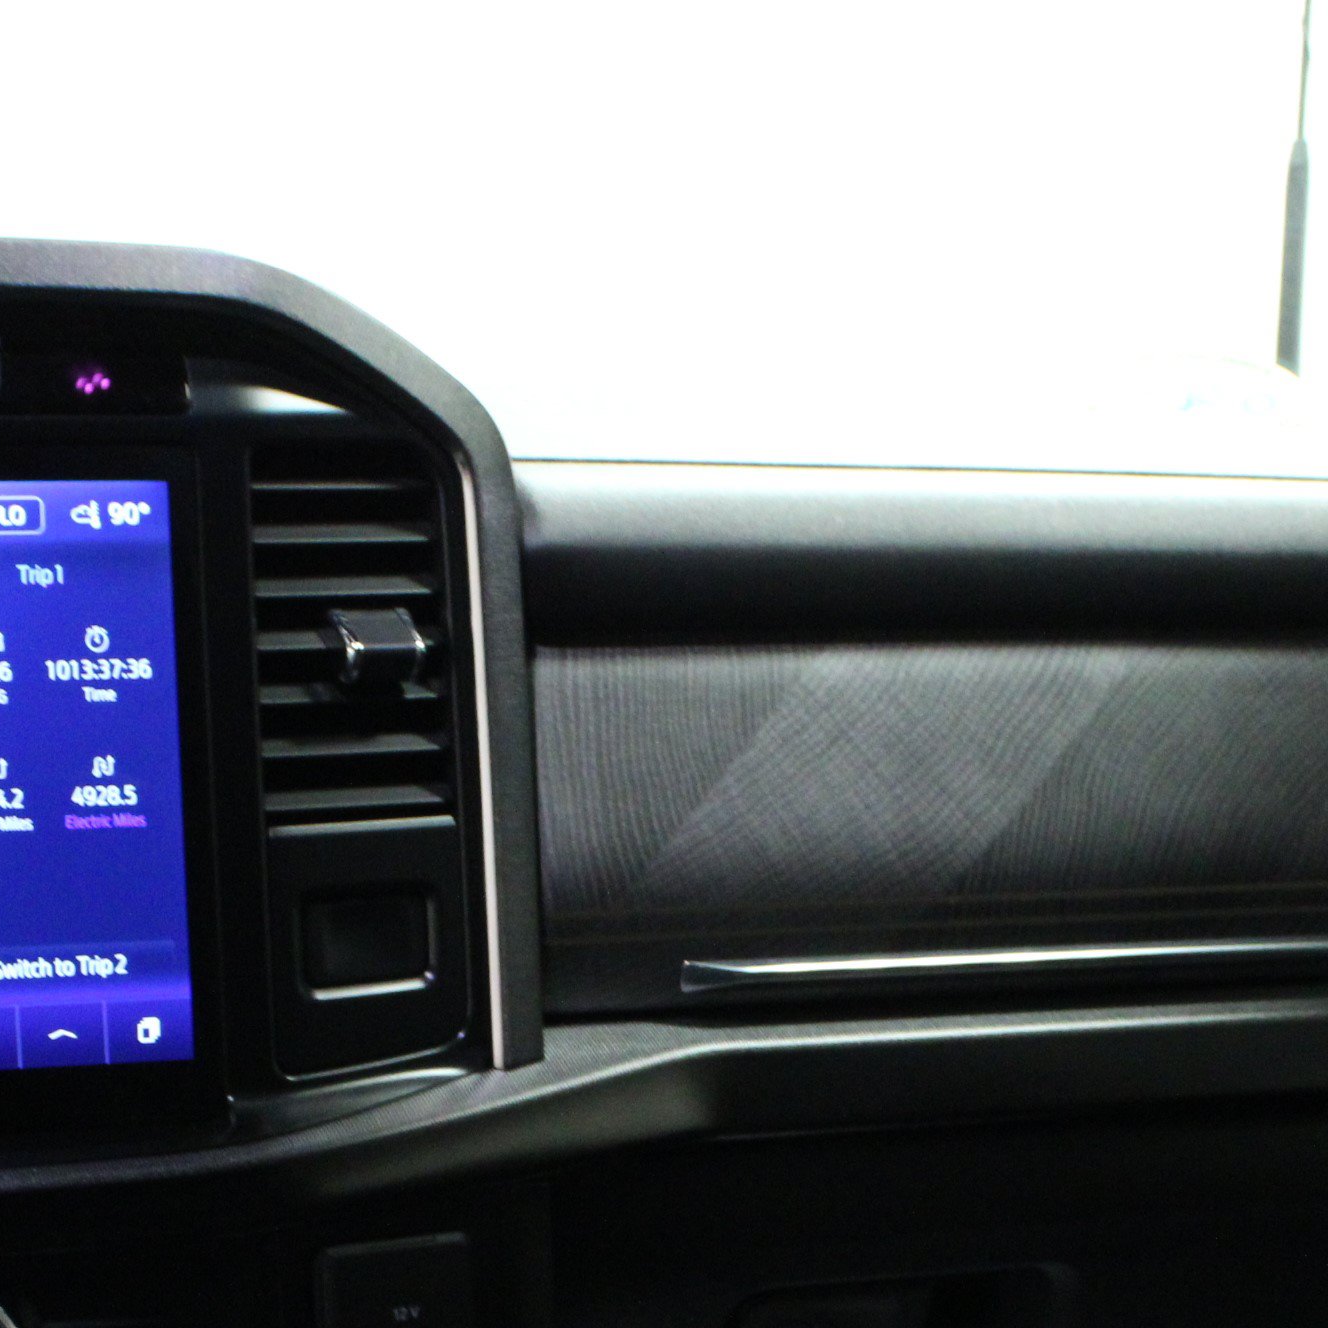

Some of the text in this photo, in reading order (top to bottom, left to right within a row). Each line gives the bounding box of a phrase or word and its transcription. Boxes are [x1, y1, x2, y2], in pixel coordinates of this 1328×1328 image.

[107, 501, 152, 527] 90°
[15, 564, 54, 588] Trip
[45, 658, 153, 682] 1013:37:36
[81, 686, 118, 703] Time
[71, 784, 139, 807] 4928.5
[0, 815, 34, 832] Miles
[65, 814, 112, 830] Electric
[54, 957, 76, 978] to
[76, 955, 114, 978] Trip
[115, 953, 128, 976] 2
